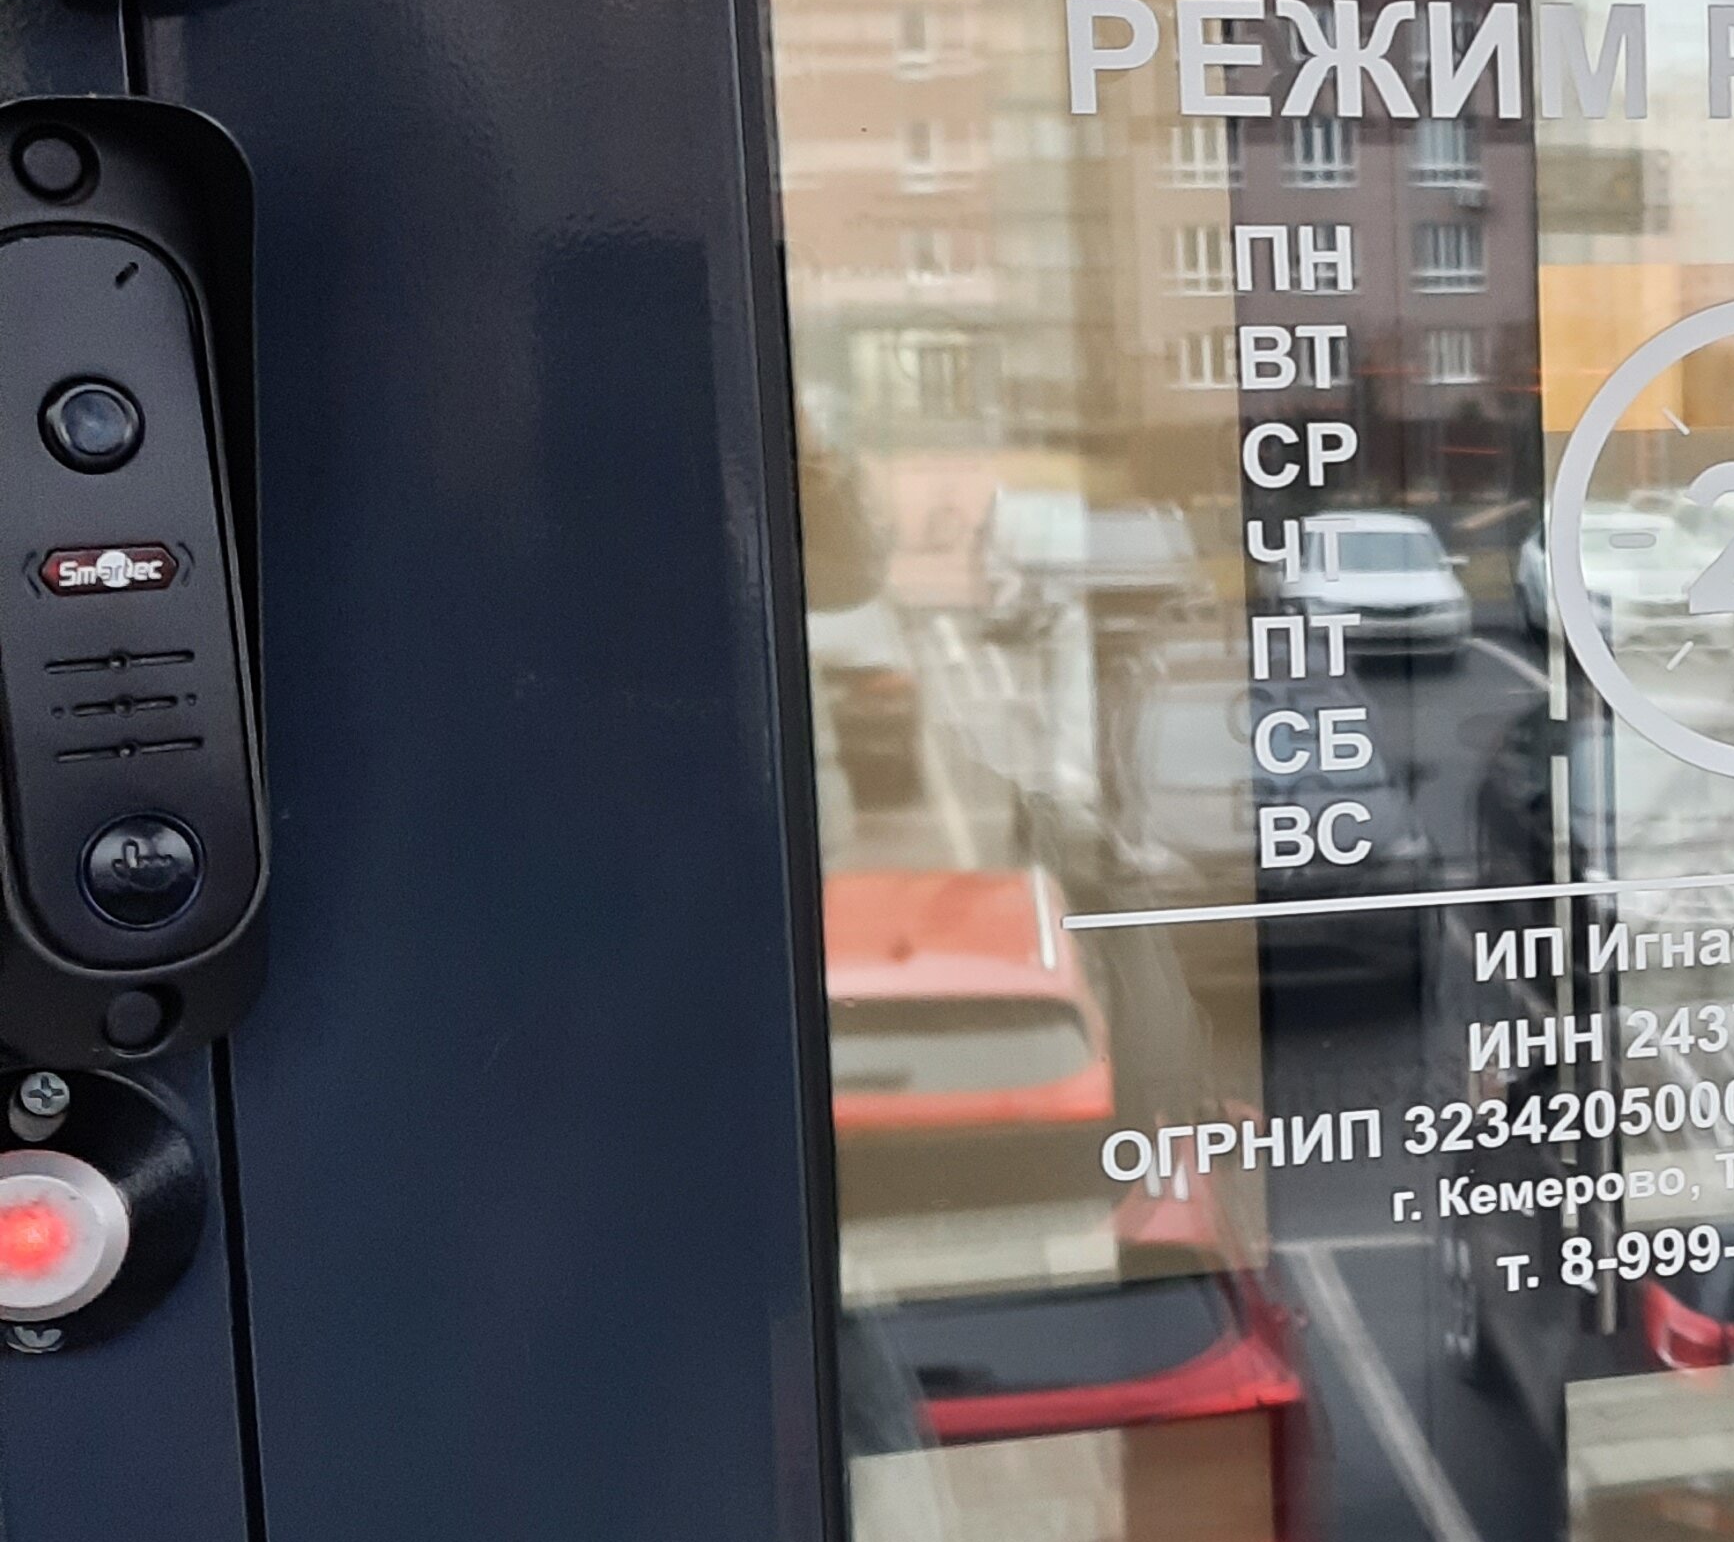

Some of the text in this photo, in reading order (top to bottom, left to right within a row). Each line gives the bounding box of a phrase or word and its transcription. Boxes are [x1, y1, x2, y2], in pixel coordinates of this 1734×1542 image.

[1235, 225, 1353, 291] ПН
[1239, 325, 1347, 390] ВТ
[1243, 422, 1358, 489] СР
[1247, 517, 1354, 583] ЧТ
[1252, 613, 1361, 680] ПТ
[1255, 708, 1373, 774] СБ
[1259, 801, 1372, 869] ВС
[1475, 927, 1564, 982] ИП
[1469, 1014, 1602, 1071] ИНН
[1102, 1109, 1381, 1181] ОГРНИП
[1393, 1190, 1422, 1221] г.
[1439, 1164, 1700, 1217] Кемерово,
[1497, 1254, 1538, 1291] т.
